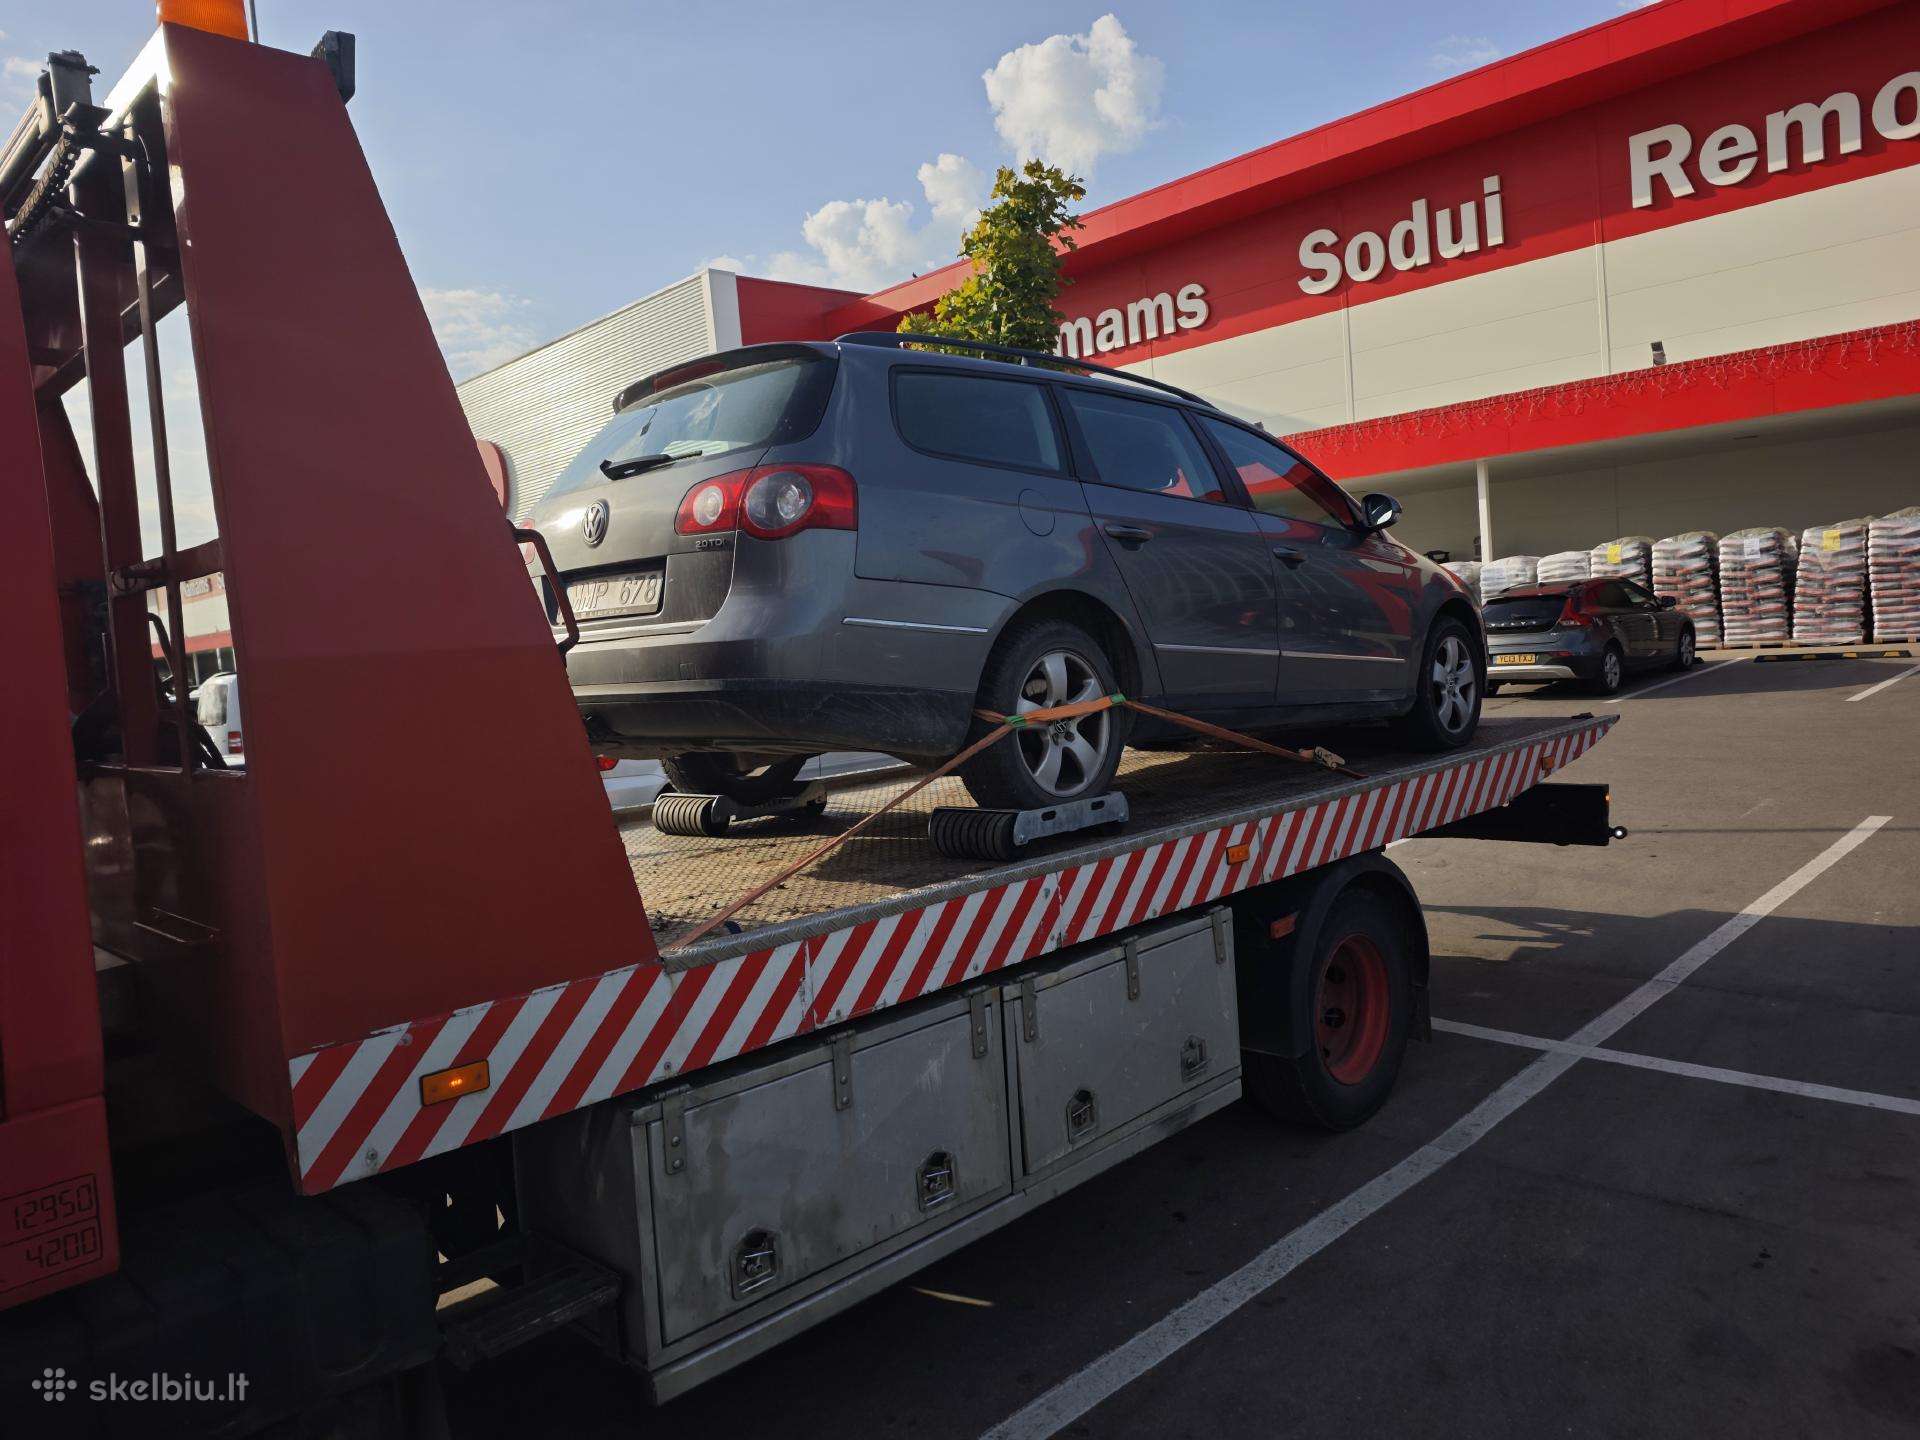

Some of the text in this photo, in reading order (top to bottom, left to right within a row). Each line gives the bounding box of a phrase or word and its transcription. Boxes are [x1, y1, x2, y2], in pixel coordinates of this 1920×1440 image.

[1298, 175, 1504, 295] Sodui
[1629, 71, 1920, 208] Remo
[620, 574, 658, 606] 678
[15, 1183, 93, 1231] 12950
[26, 1226, 97, 1268] 4200
